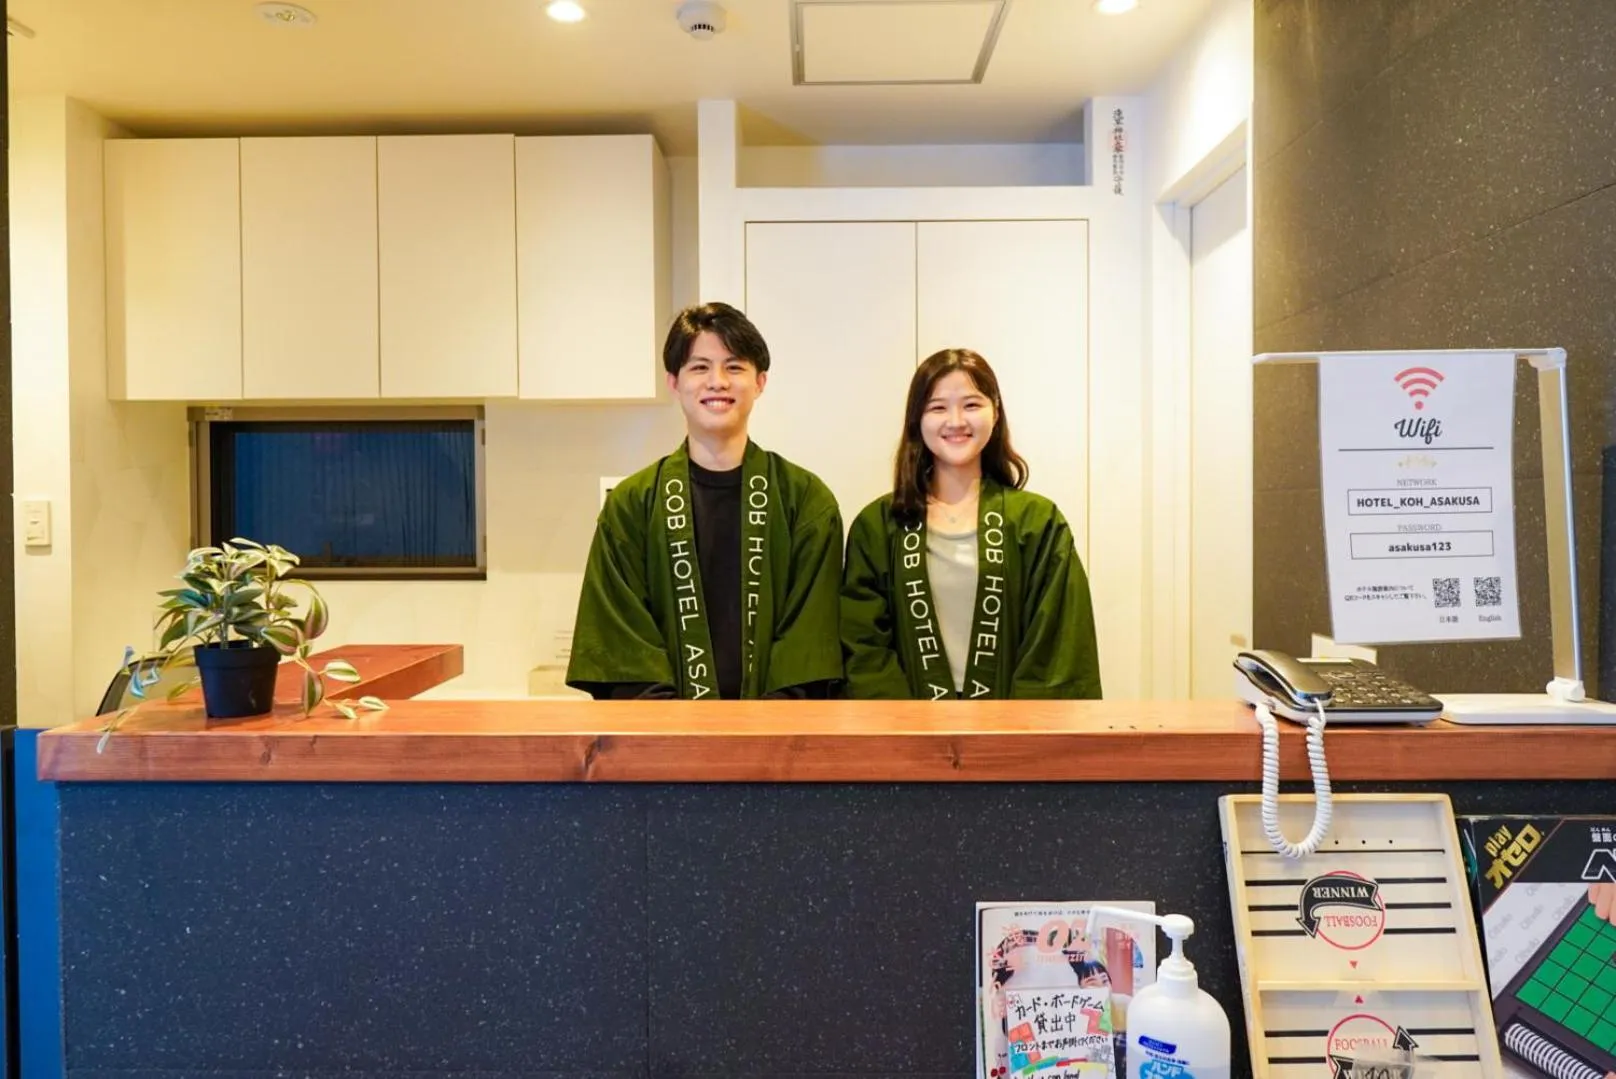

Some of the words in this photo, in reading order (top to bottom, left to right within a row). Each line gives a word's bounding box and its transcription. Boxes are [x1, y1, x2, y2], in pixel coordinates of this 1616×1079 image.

[1394, 417, 1442, 445] Wifi
[1396, 478, 1437, 486] NETWORK
[665, 478, 686, 530] COB
[749, 475, 768, 526] COB
[1357, 496, 1480, 510] HOTEL_KOH_ASAKUSA
[984, 511, 1004, 564] COB
[1397, 523, 1442, 532] PASSWORD
[1388, 541, 1452, 553] asakusa123
[670, 540, 700, 631] HOTEL
[905, 579, 940, 671] HOTEL
[974, 575, 1004, 666] HOTEL
[1478, 614, 1502, 623] English
[685, 644, 710, 700] ASA
[1484, 824, 1513, 857] play
[1484, 823, 1542, 889] オセロ
[1313, 886, 1371, 899] WINNER
[1324, 914, 1378, 928] FOOSBALL
[1034, 1012, 1076, 1035] 貸出中
